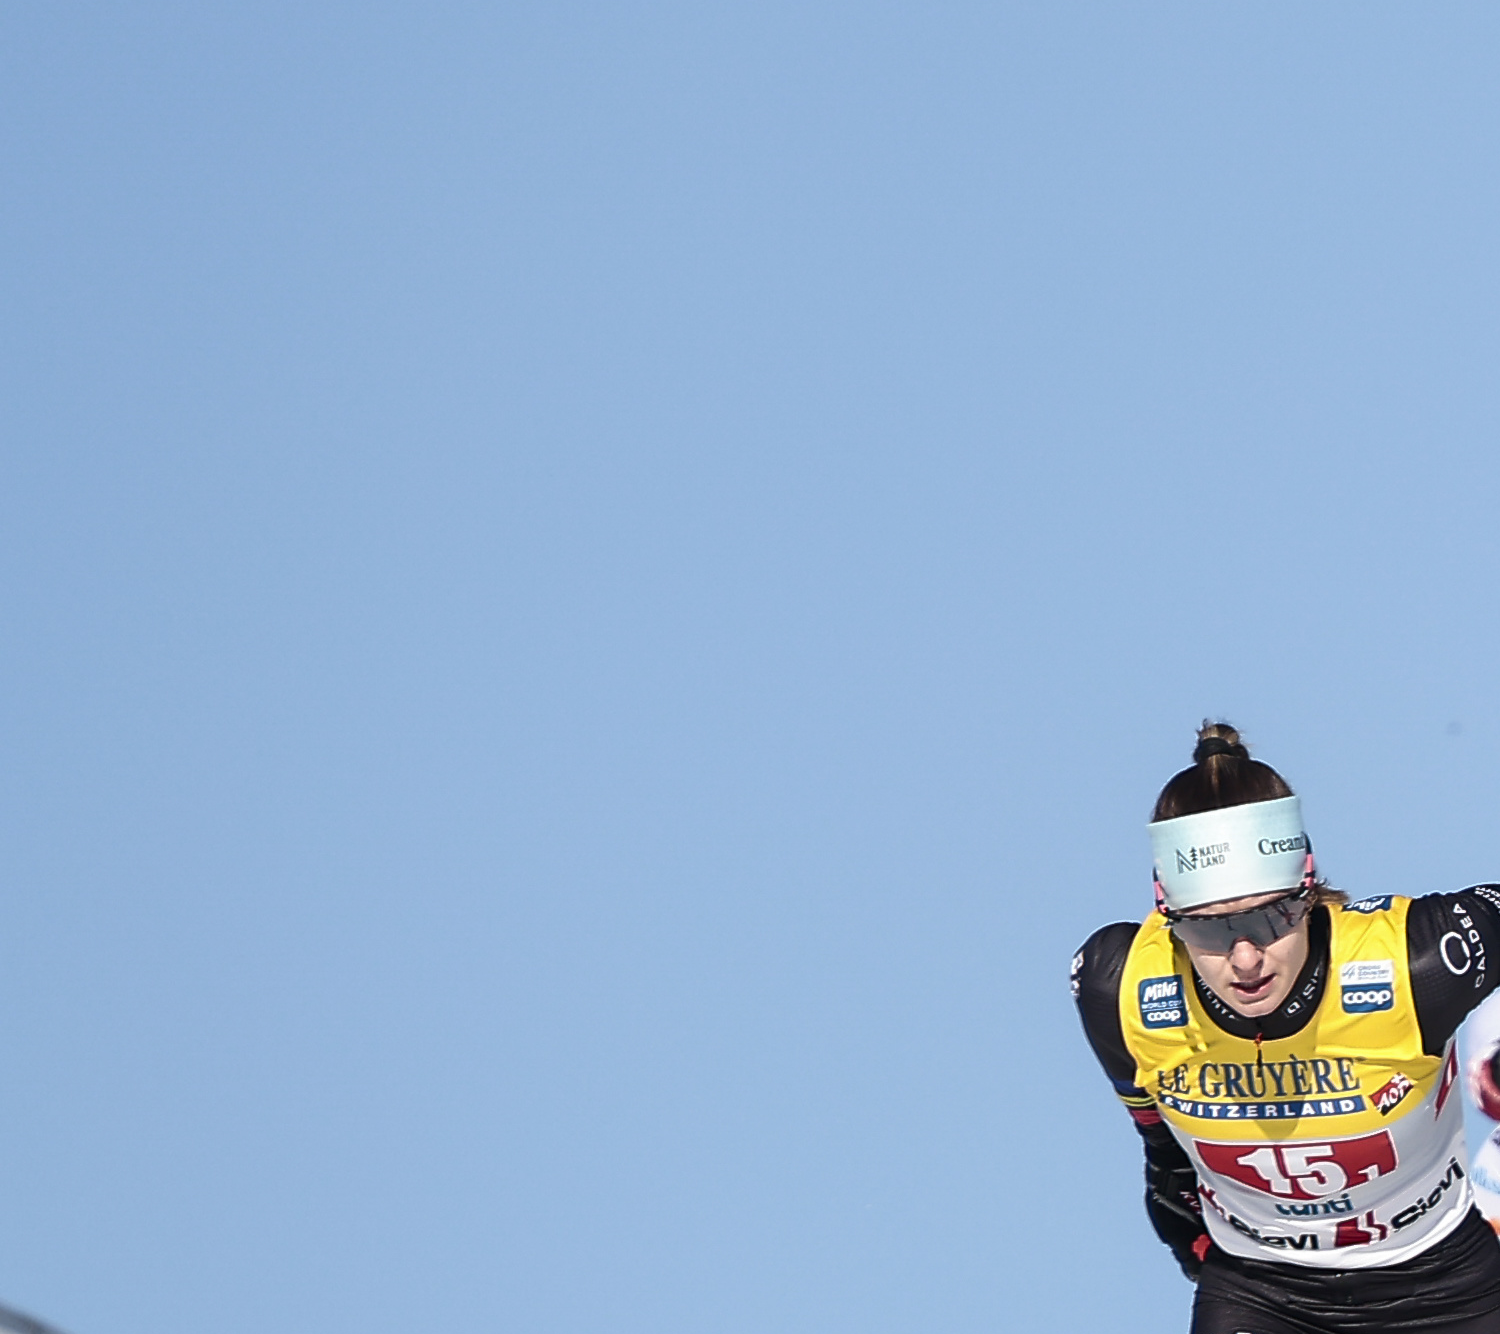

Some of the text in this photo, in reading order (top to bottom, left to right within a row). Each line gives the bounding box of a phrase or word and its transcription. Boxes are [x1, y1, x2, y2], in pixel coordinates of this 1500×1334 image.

[1198, 842, 1230, 858] NATUR
[1199, 854, 1226, 868] LAND
[1342, 990, 1391, 1006] coop
[1146, 1009, 1181, 1023] coop
[1199, 1053, 1361, 1098] GRUYÈRE
[1236, 1144, 1348, 1197] 15
